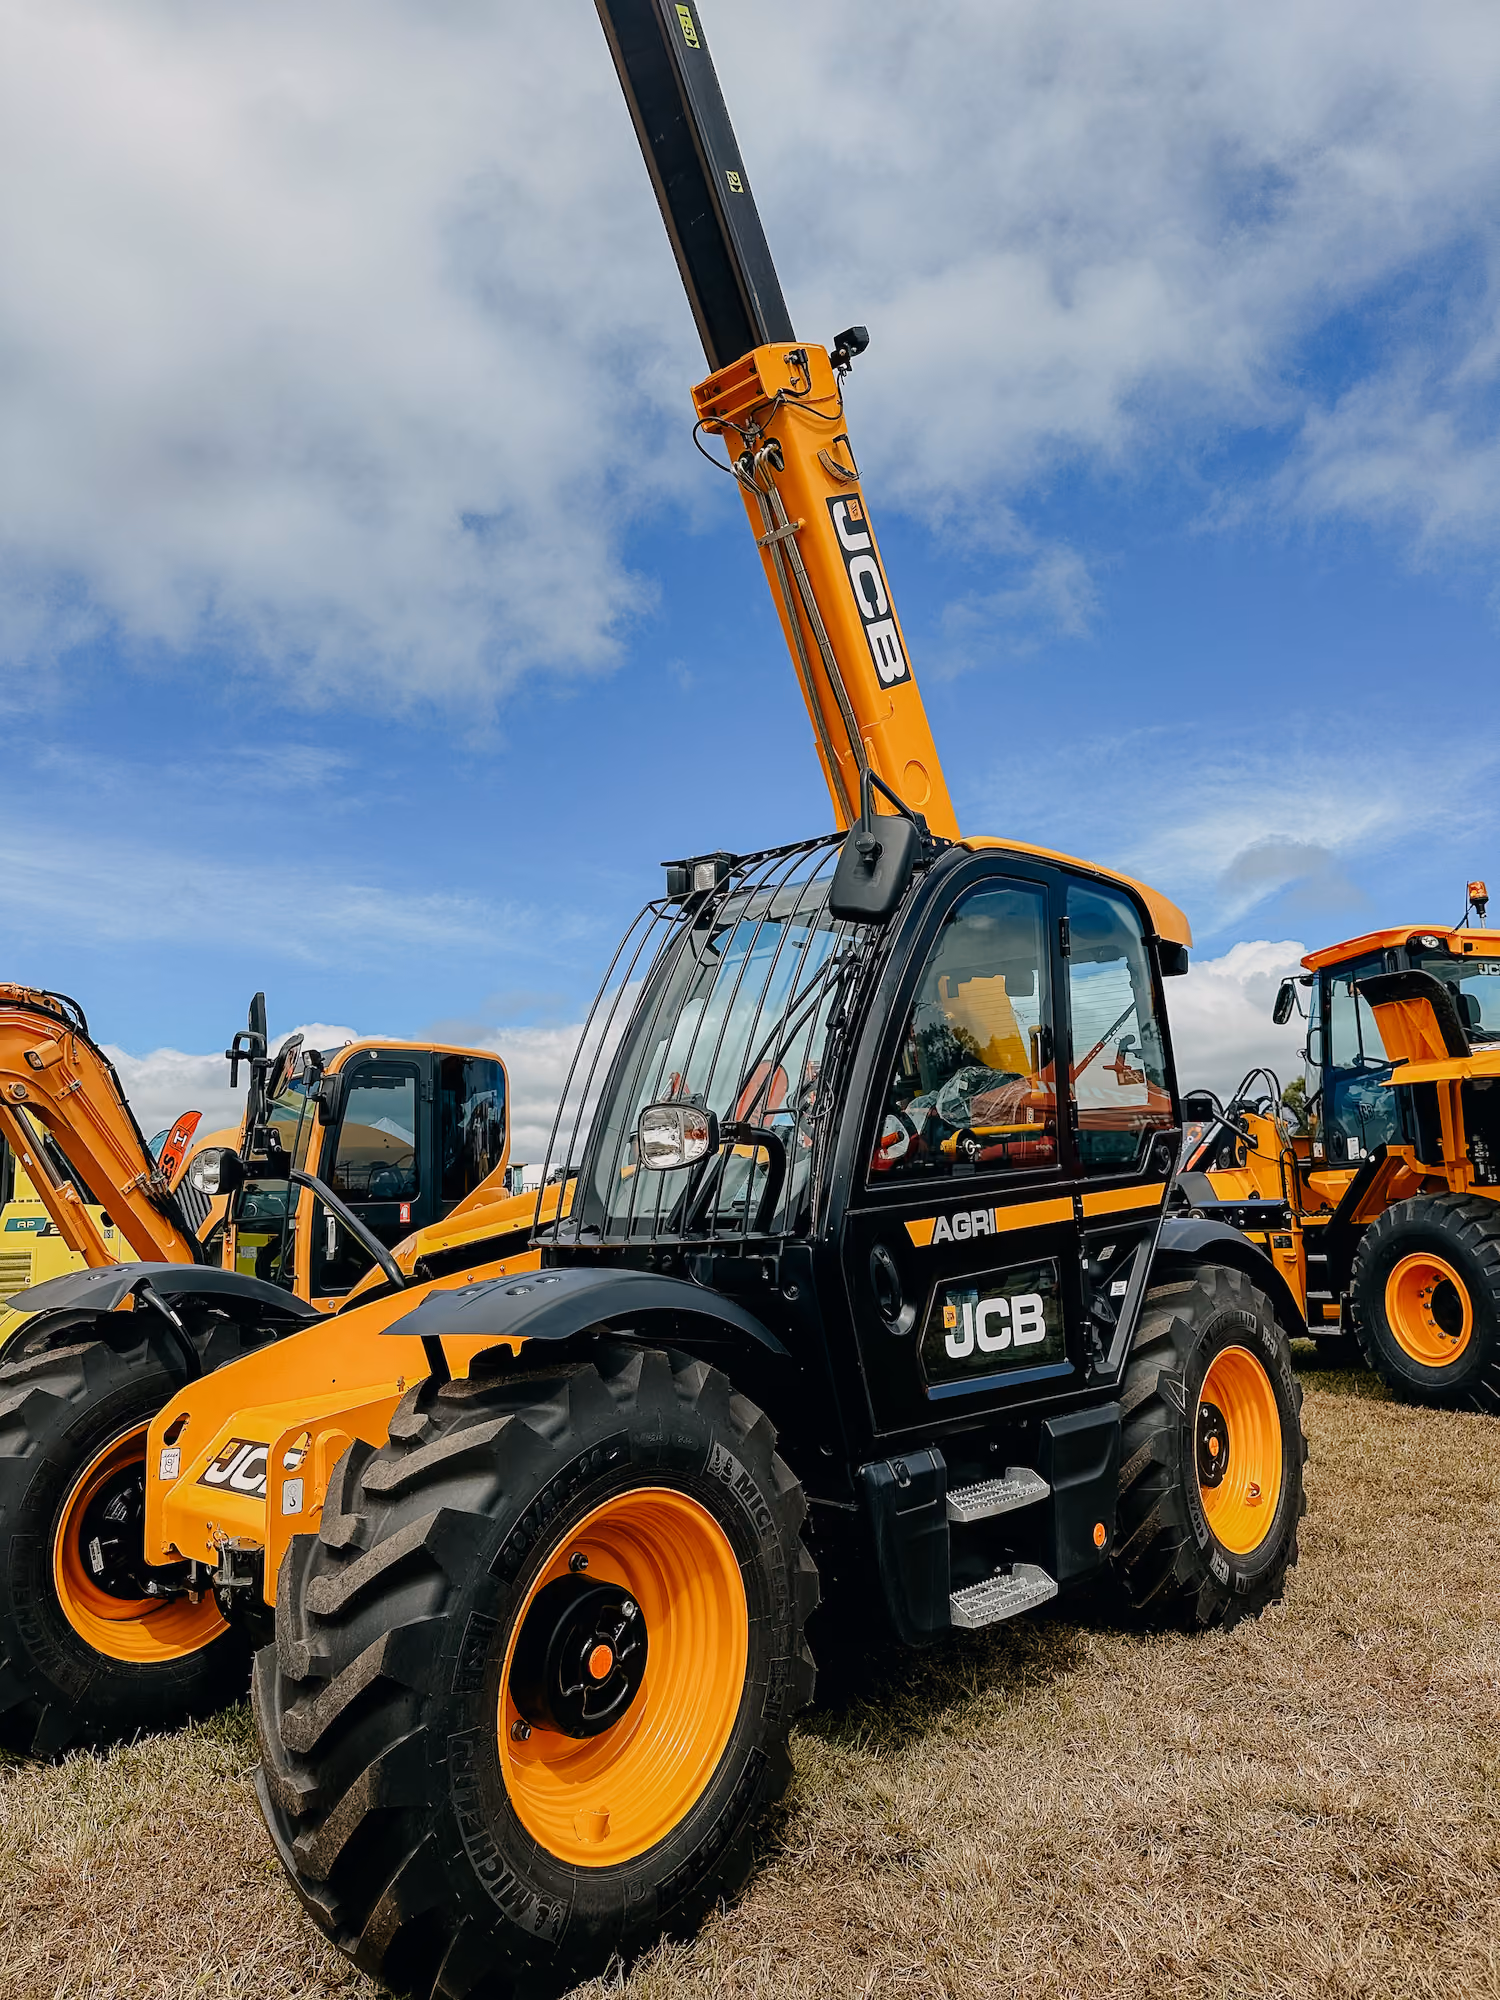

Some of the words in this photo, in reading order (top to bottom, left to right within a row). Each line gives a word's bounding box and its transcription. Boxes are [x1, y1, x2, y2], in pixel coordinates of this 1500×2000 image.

[832, 500, 906, 684] JCB
[1478, 963, 1500, 976] JC
[16, 1220, 36, 1229] AP
[932, 1207, 997, 1245] AGRI
[944, 1292, 1047, 1359] JCB
